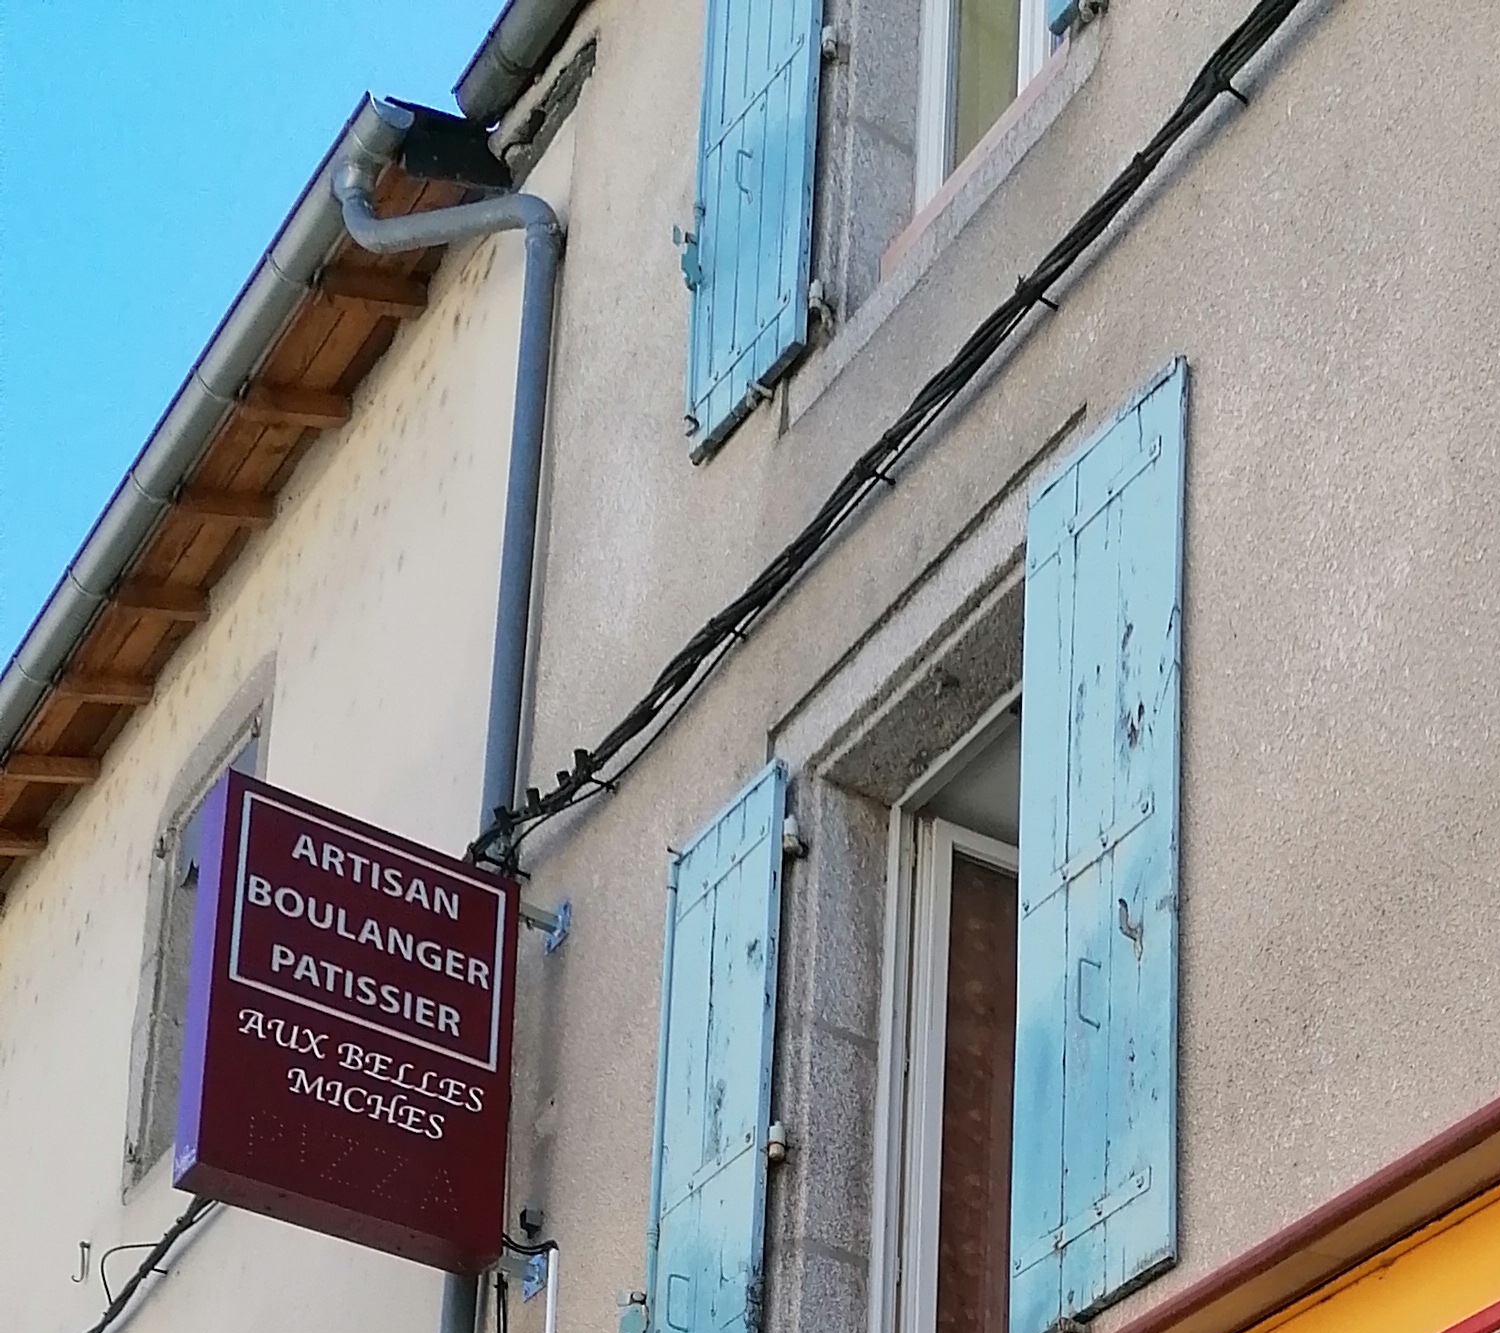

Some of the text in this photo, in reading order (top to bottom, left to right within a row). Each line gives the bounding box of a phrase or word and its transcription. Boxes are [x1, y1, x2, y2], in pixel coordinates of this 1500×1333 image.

[292, 834, 460, 920] ARTISAN
[248, 875, 490, 990] BOULANGER
[272, 944, 461, 1037] PATISSIER
[238, 1009, 484, 1112] AUX BELLES
[288, 1068, 445, 1140] MICHES
